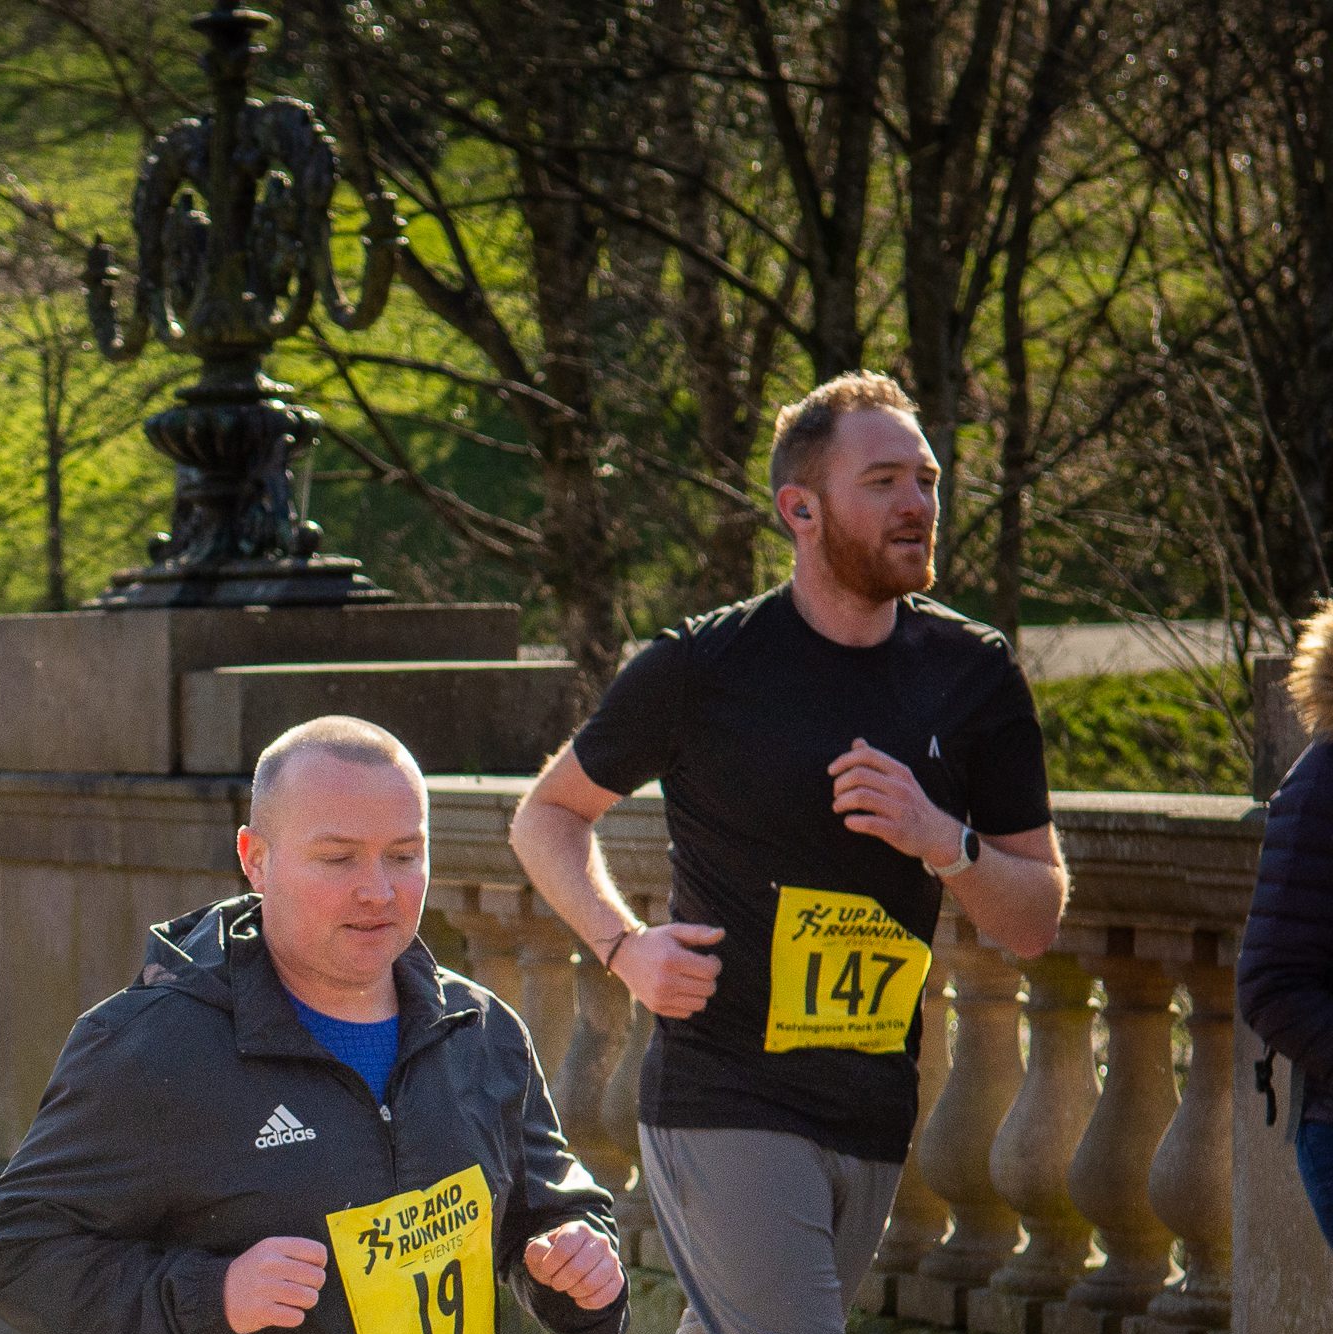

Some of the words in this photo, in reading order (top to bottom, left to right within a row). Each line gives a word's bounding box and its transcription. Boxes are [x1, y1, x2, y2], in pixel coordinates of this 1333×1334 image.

[805, 951, 908, 1017] 147
[255, 1127, 316, 1148] adidas
[397, 1205, 419, 1229] UP
[422, 1184, 462, 1222] AND
[398, 1200, 479, 1257] RUNNING
[424, 1234, 464, 1264] EVENTS
